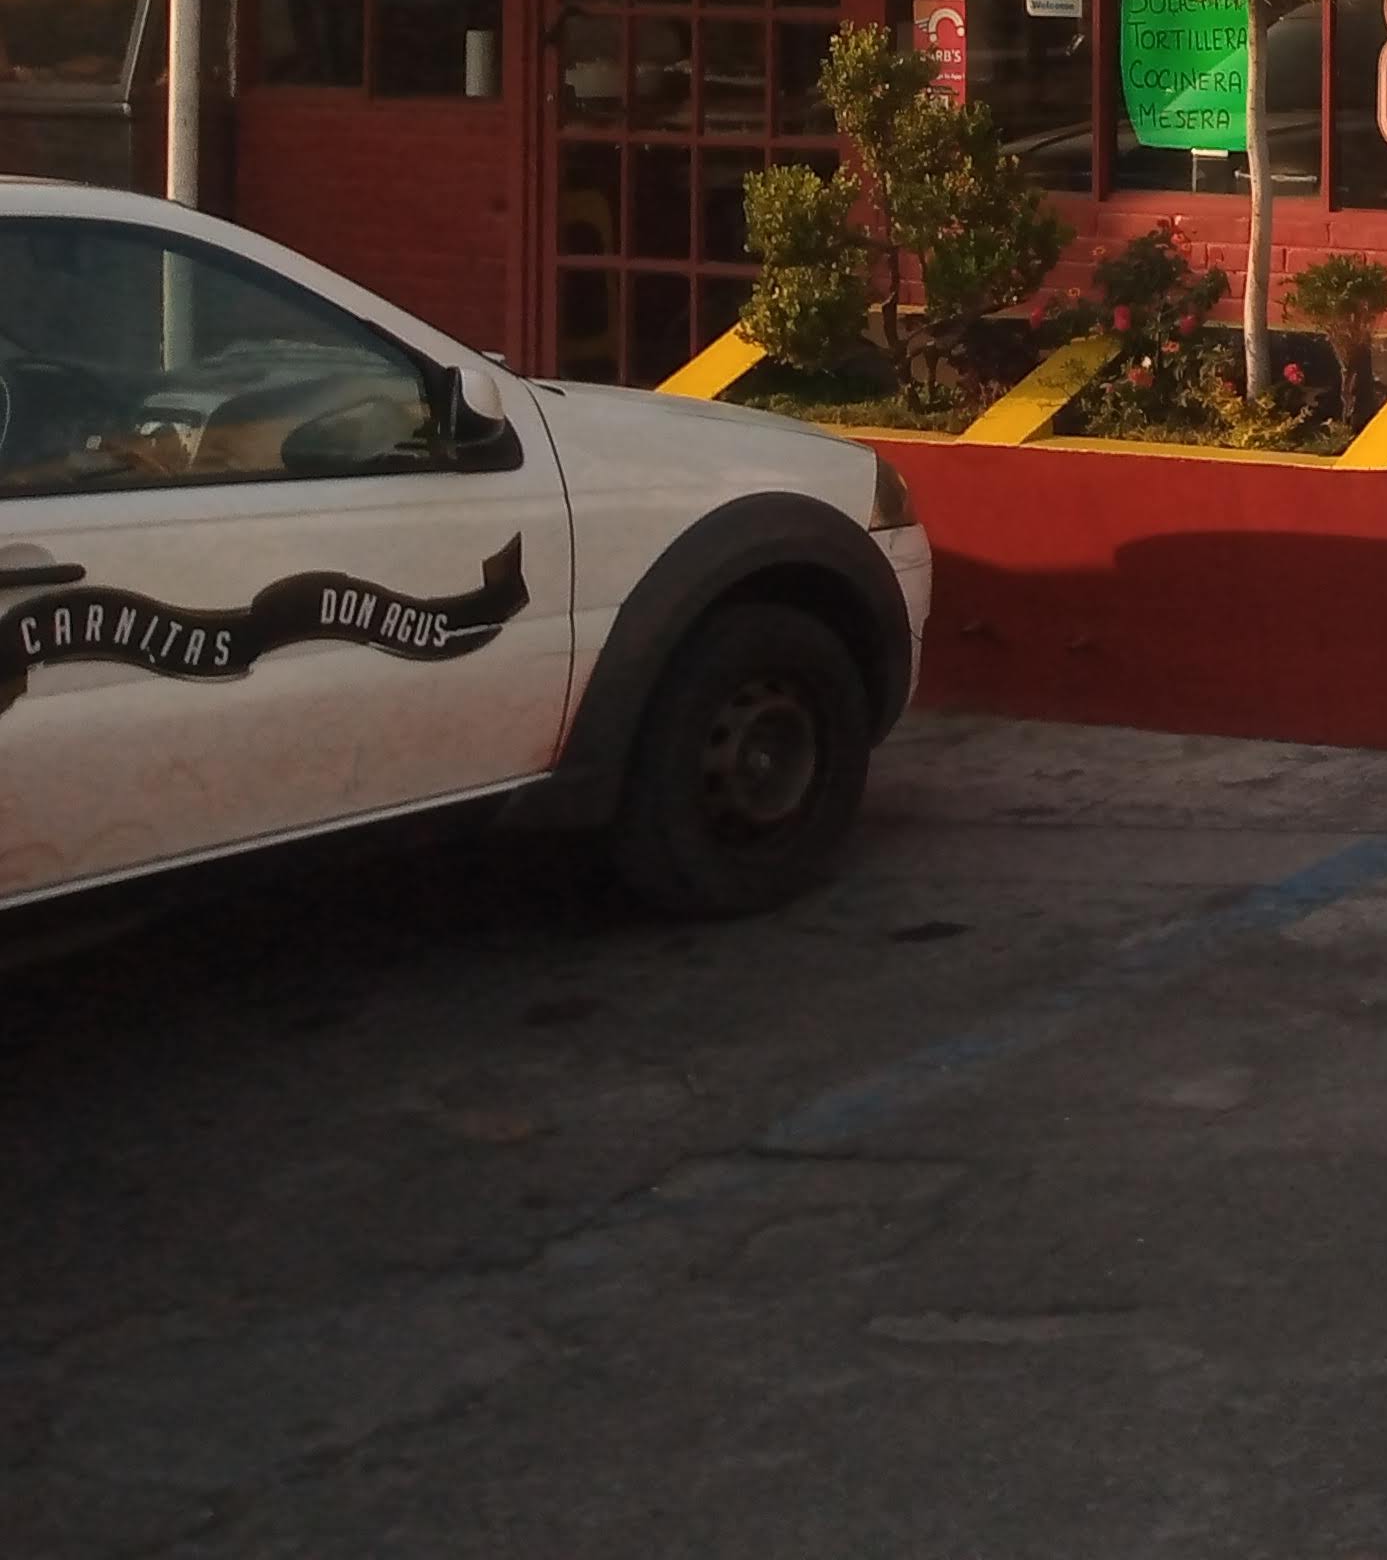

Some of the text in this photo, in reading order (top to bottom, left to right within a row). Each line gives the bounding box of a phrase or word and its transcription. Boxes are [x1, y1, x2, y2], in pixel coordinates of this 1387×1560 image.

[1031, 0, 1075, 11] Welcome
[1128, 21, 1247, 51] TORTILLERA
[1129, 59, 1241, 94] COCINERA
[1138, 103, 1231, 129] MESERA
[321, 589, 448, 647] DON AGUS
[20, 604, 232, 667] CARNITAS
